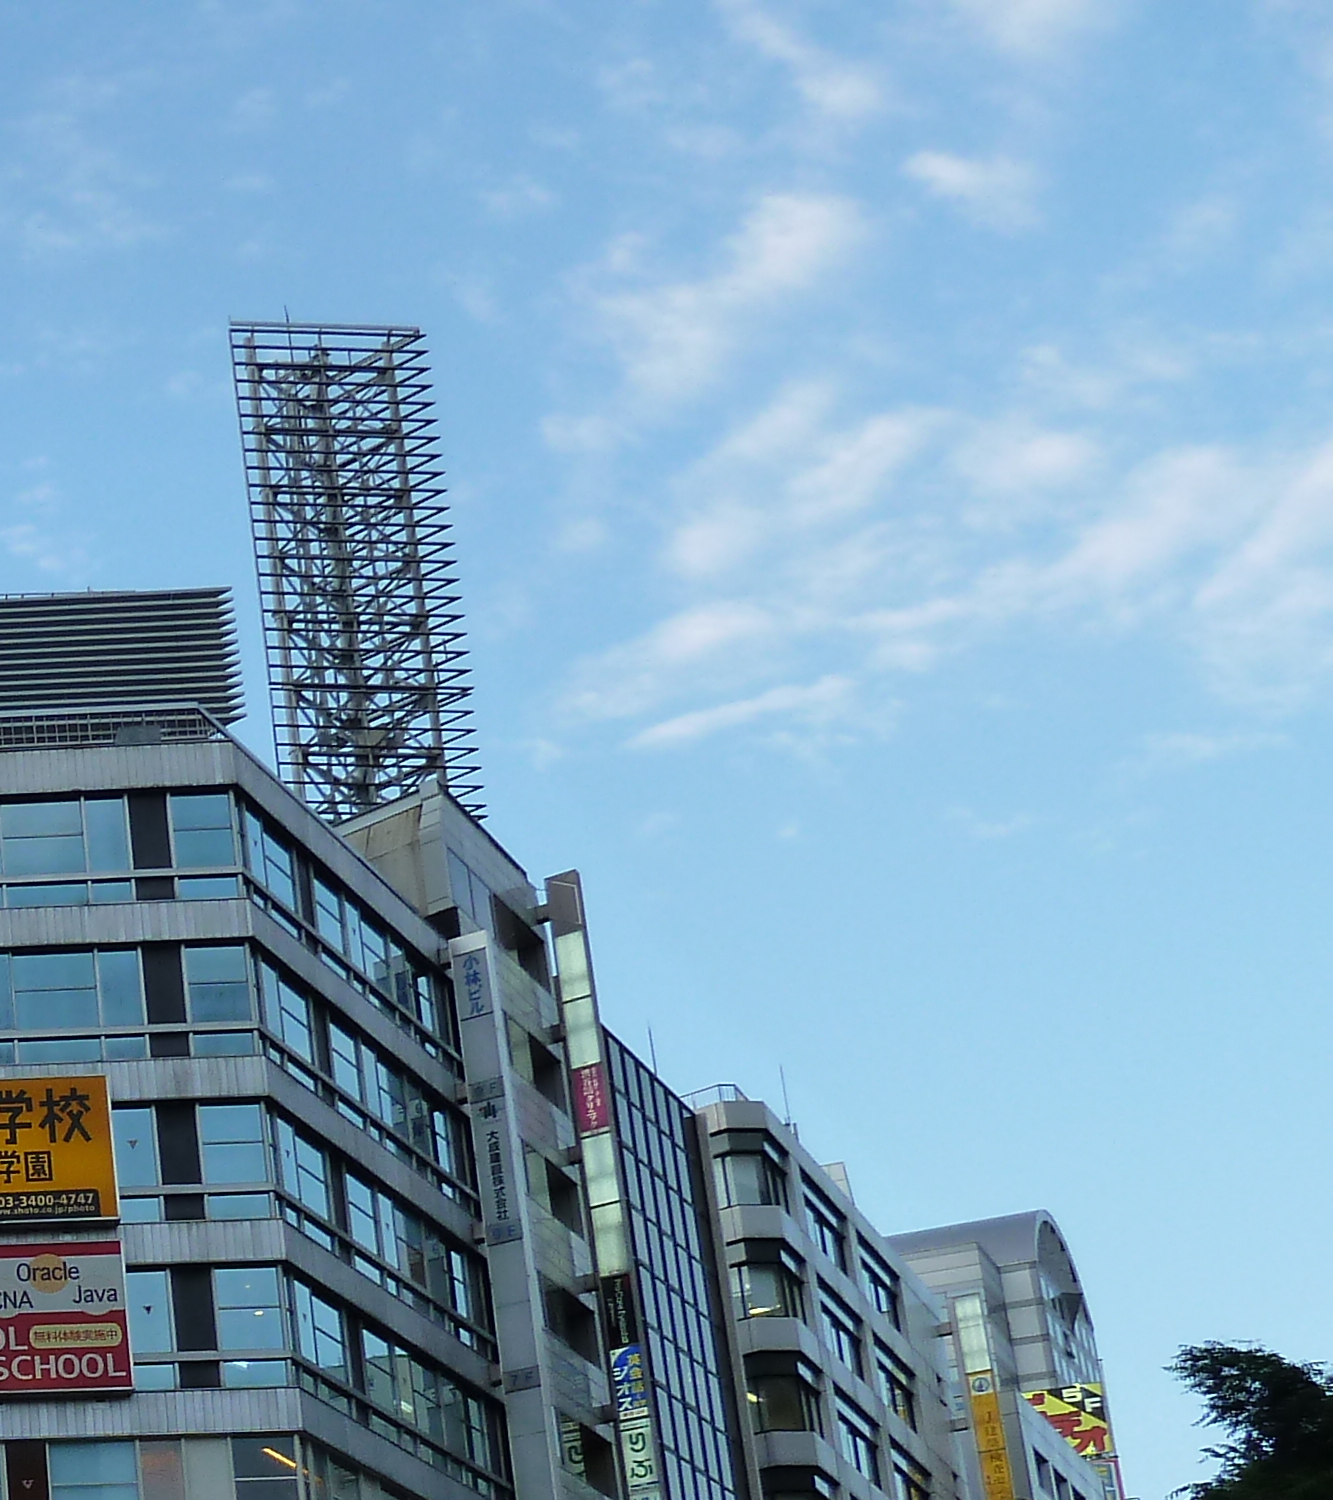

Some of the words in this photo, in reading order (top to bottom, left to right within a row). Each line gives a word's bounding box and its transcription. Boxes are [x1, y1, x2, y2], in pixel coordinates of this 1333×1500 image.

[462, 955, 485, 1016] 小林ビル
[16, 1262, 80, 1283] Oracle
[73, 1285, 118, 1305] Java
[613, 1367, 633, 1411] ジオス
